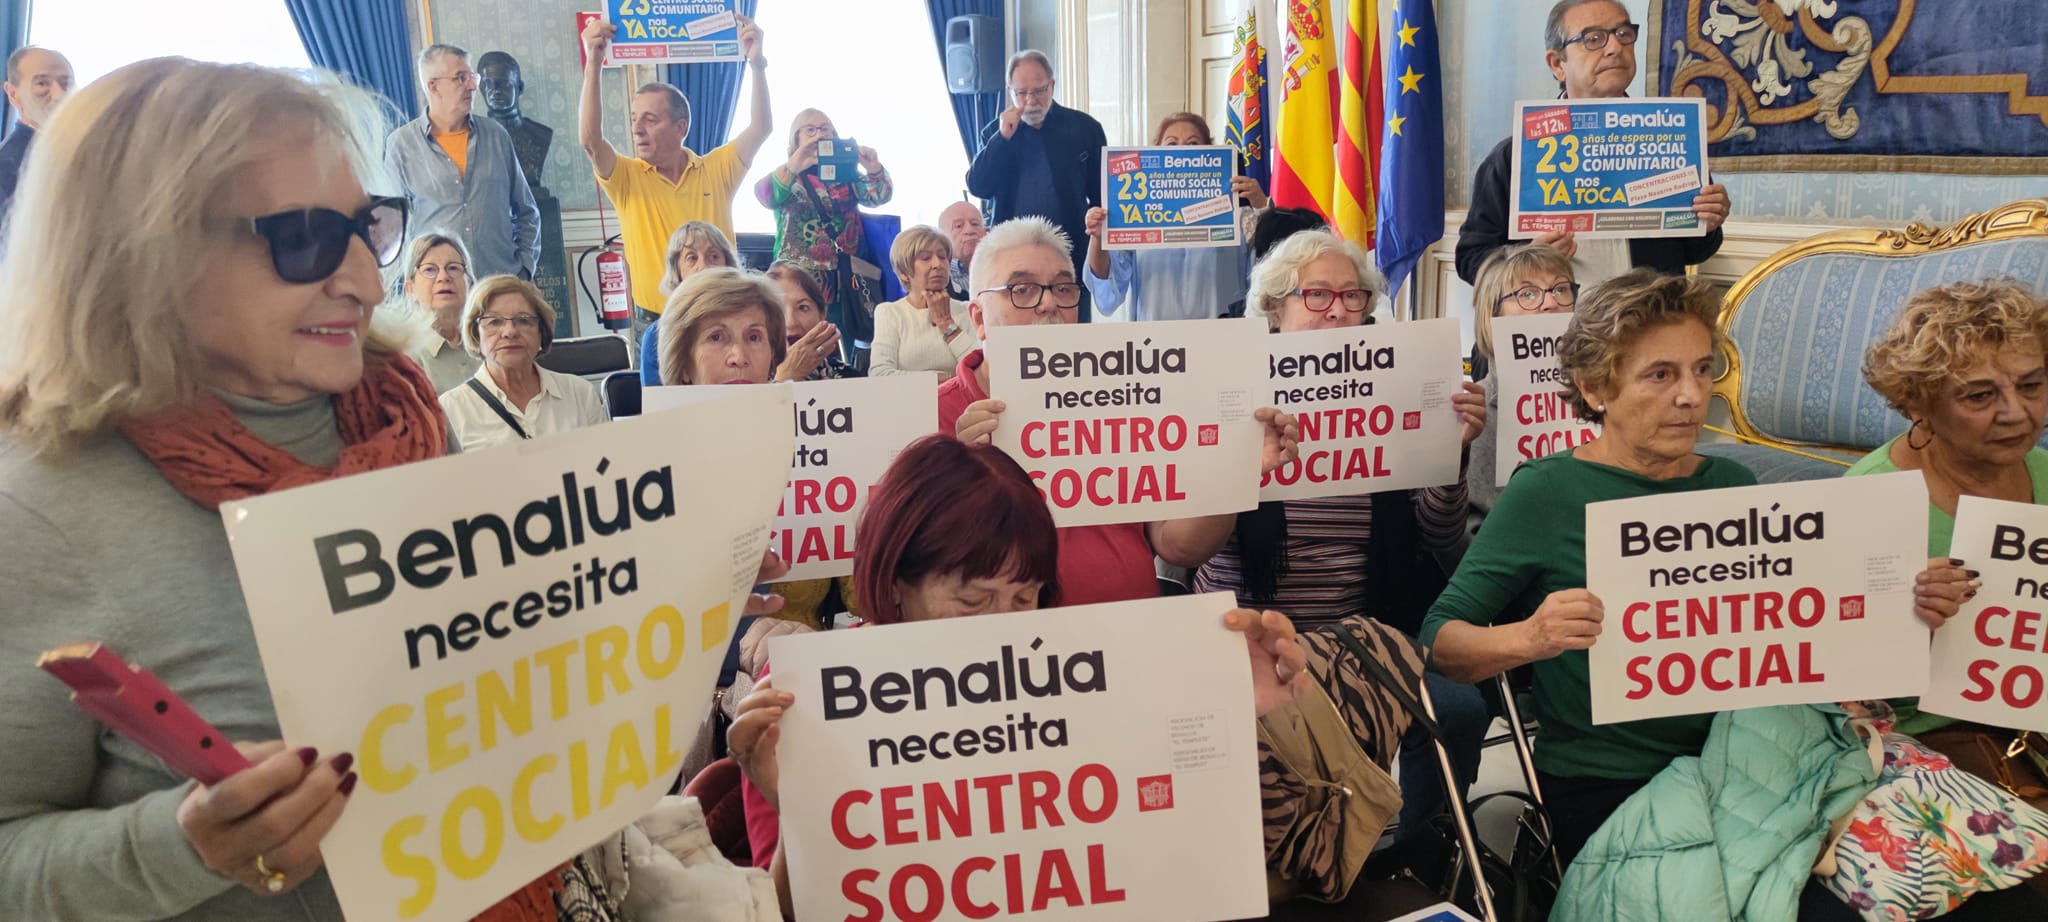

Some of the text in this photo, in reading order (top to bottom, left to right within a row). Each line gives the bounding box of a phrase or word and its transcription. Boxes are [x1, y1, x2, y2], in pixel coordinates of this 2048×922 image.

[648, 18, 667, 26] nos
[652, 5, 725, 15] COMUNITARIO
[622, 19, 648, 38] YA
[648, 26, 689, 38] TOCA
[1542, 118, 1568, 134] 12h.
[1605, 109, 1686, 128] Benalúa
[1582, 133, 1686, 146] años de espera por un
[1582, 142, 1687, 157] CENTRO SOCIAL
[1120, 160, 1138, 171] 12h.
[1164, 153, 1222, 168] Benalúa
[1536, 134, 1580, 174] 23
[1582, 156, 1687, 172] COMUNITARIO
[1117, 171, 1148, 200] 23
[1149, 171, 1165, 179] años
[1176, 172, 1199, 181] espera
[1149, 178, 1222, 189] CENTRO SOCIAL
[1574, 177, 1600, 188] nos
[1629, 171, 1687, 192] CONCENTRACIONES
[1149, 188, 1223, 200] COMUNITARIO
[1537, 179, 1571, 206] YA
[1574, 187, 1627, 205] TOCA
[1119, 203, 1143, 224] YA
[1144, 203, 1163, 211] nos
[1144, 210, 1184, 223] TOCA
[1019, 338, 1186, 380] Benalúa
[1045, 382, 1162, 410] necesita
[1274, 378, 1374, 406] necesita
[1020, 414, 1188, 459] CENTRO
[1298, 404, 1395, 443] NTRO
[1260, 446, 1392, 488] OCIAL
[313, 456, 676, 615] Benalúa
[1620, 502, 1825, 558] Benalúa
[1649, 553, 1793, 588] necesita
[404, 556, 639, 669] necesita
[1622, 587, 1826, 644] CENTRO
[820, 637, 1107, 721] Benalúa
[1625, 642, 1825, 700] SOCIAL
[358, 604, 686, 794] CENTRO
[868, 712, 1069, 768] necesita
[380, 703, 682, 920] SOCIAL
[831, 763, 1119, 850] CENTRO
[840, 843, 1126, 922] SOCIAL
